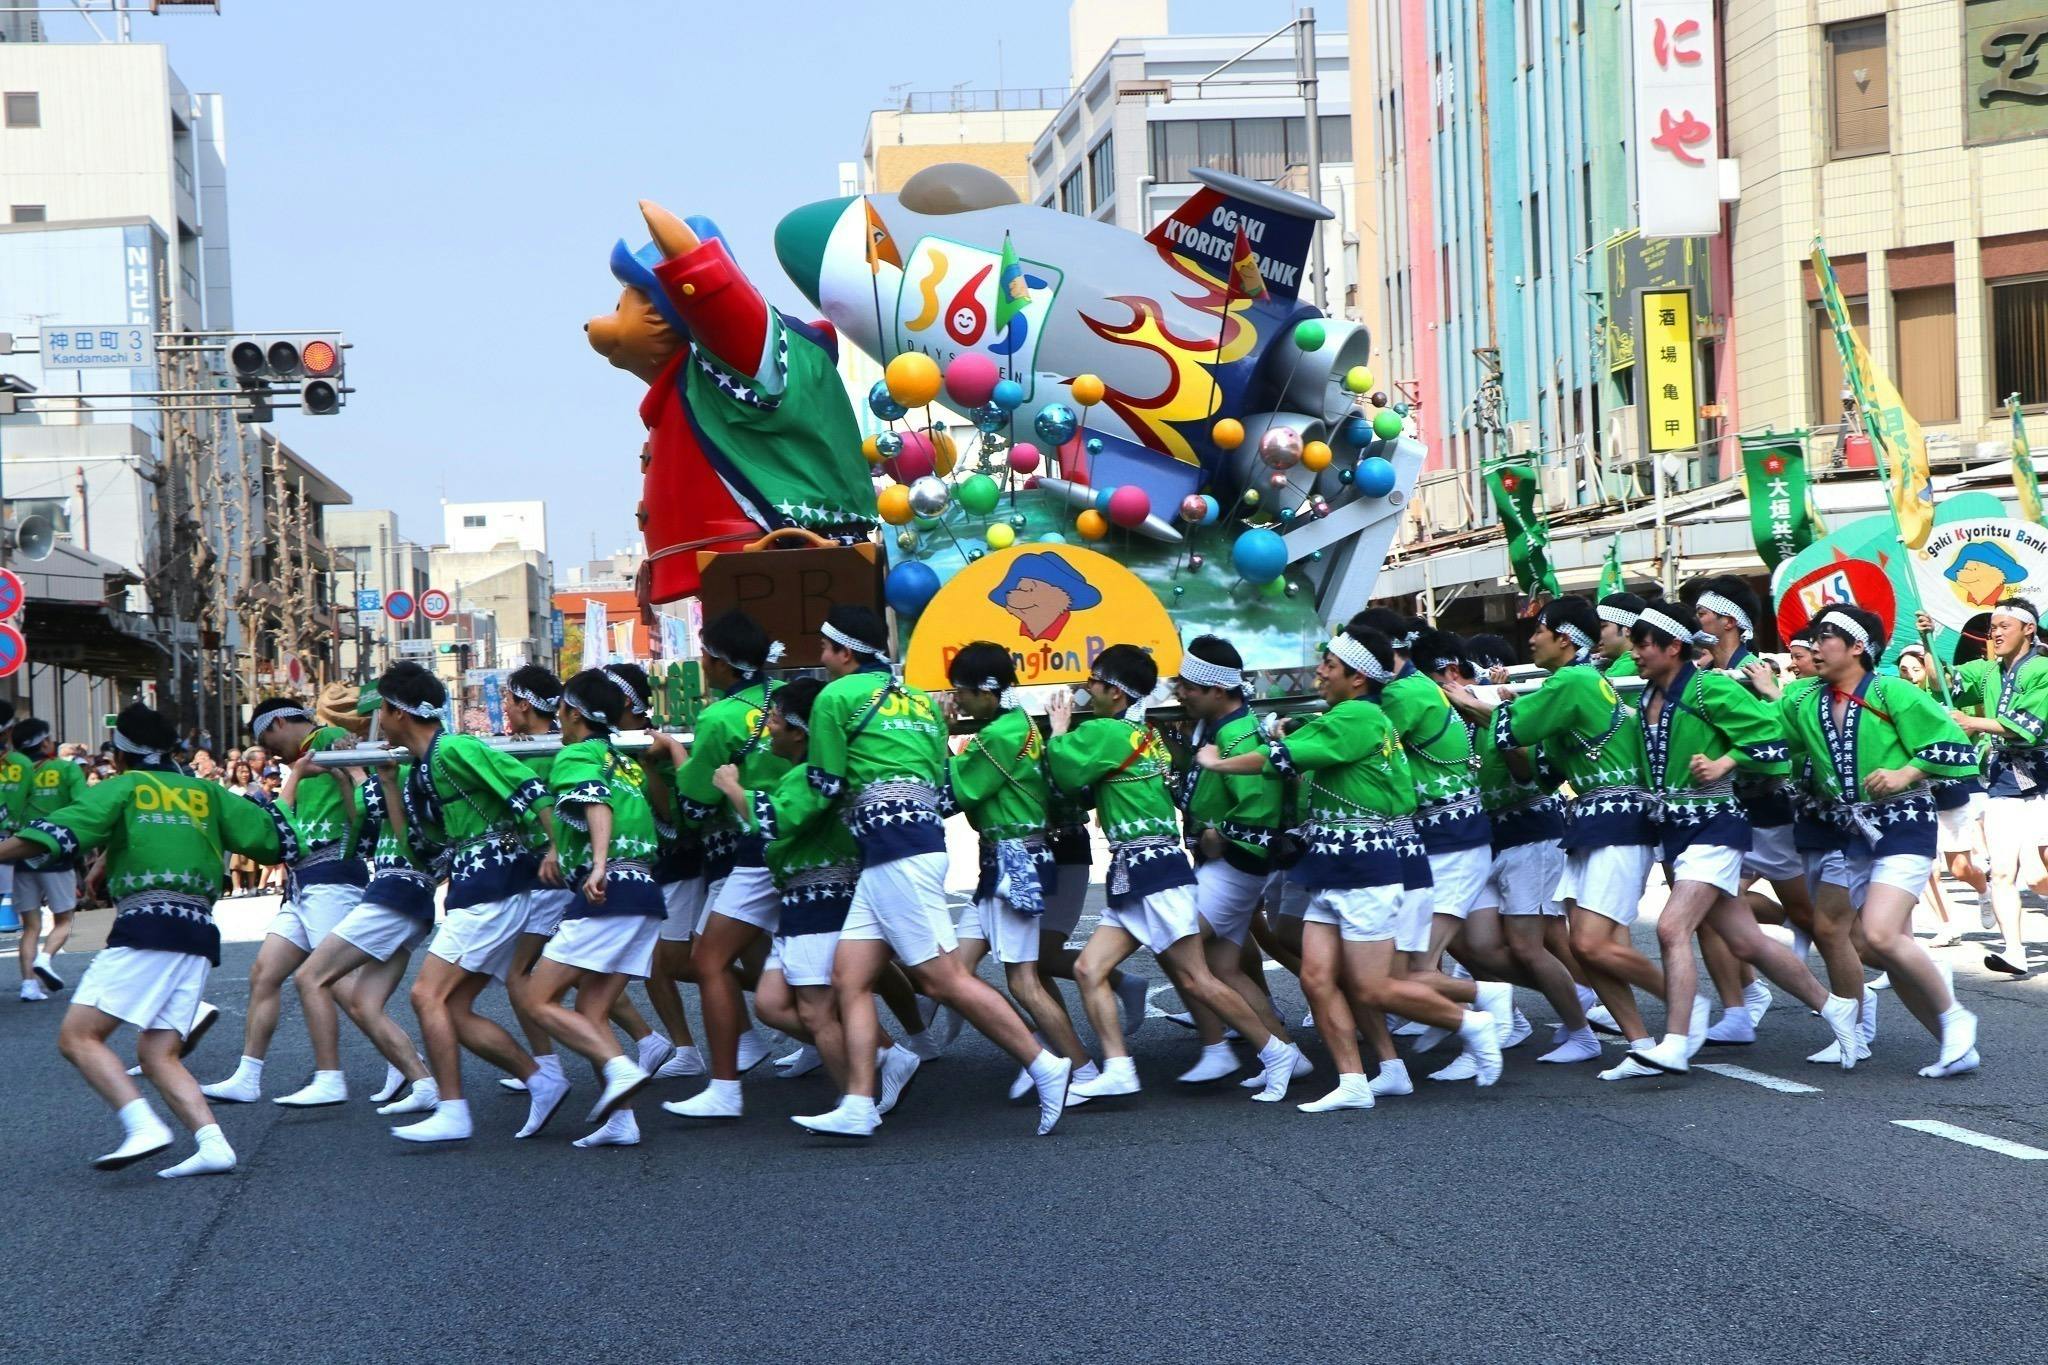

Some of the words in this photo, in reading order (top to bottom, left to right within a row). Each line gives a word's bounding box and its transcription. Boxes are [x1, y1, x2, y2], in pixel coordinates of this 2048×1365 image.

[1164, 218, 1235, 262] KYORITS
[53, 353, 128, 364] Kandamachi
[134, 353, 143, 362] 3
[1659, 308, 1680, 436] 酒場亀甲
[1767, 477, 1797, 560] 大垣共立
[1919, 533, 1952, 560] Ogaki
[1954, 525, 2011, 542] Kyoritsu
[427, 597, 443, 611] 50
[942, 642, 1081, 680] Pngton
[135, 784, 210, 818] OKB
